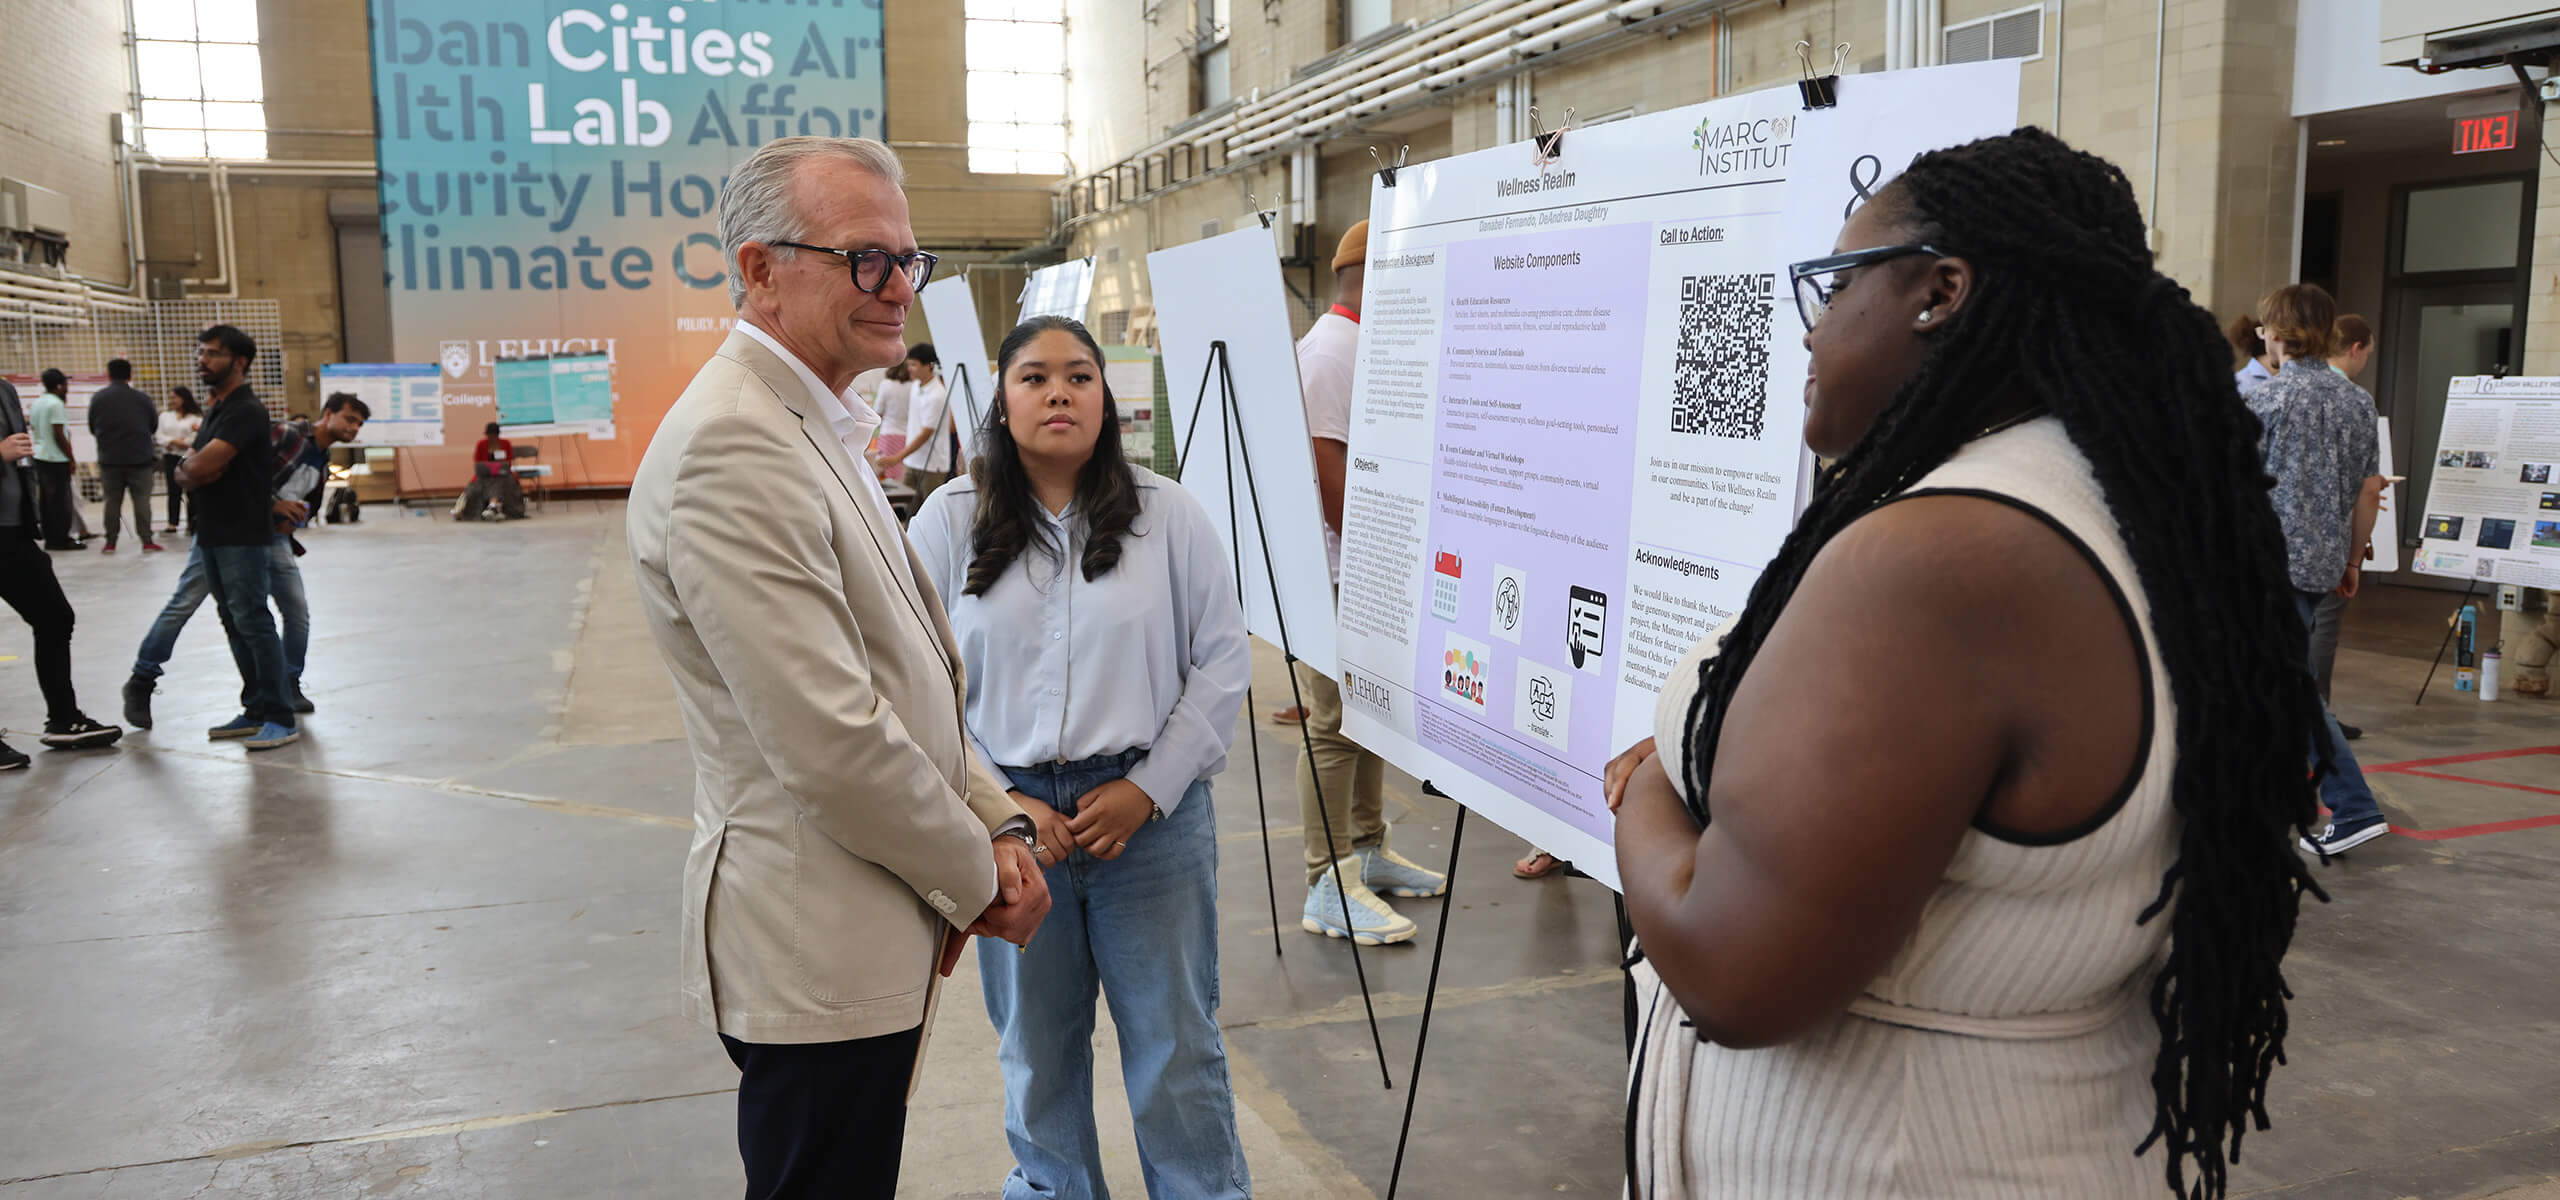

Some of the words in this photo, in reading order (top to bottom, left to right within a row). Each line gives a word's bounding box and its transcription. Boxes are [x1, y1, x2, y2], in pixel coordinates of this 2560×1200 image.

[372, 0, 529, 67] ban
[547, 3, 773, 78] Cities
[374, 72, 504, 142] lth
[528, 78, 671, 147] Lab
[688, 83, 885, 147] Affor
[611, 160, 738, 218] Ho
[1497, 177, 1541, 198] Wellness
[1542, 168, 1576, 191] Realm
[1505, 215, 1537, 230] Fernando,
[1538, 209, 1573, 225] DeAndrea
[1574, 205, 1608, 223] Daughtry
[1660, 228, 1677, 244] Call
[1679, 229, 1689, 242] to
[1690, 225, 1724, 242] Action:
[384, 223, 653, 291] limate
[1405, 251, 1434, 267] Background
[1494, 255, 1525, 272] Website
[1526, 250, 1581, 270] Components
[1593, 306, 1611, 317] disease
[2473, 376, 2493, 393] 16
[444, 393, 491, 407] College
[1587, 422, 1618, 437] personalized
[1649, 456, 1662, 468] Join
[1662, 460, 1670, 468] us
[1671, 459, 1678, 469] in
[1678, 462, 1690, 472] our
[1690, 461, 1715, 474] mission
[1715, 465, 1722, 475] to
[1723, 467, 1753, 481] empower
[1754, 467, 1781, 484] wellness
[1651, 472, 1657, 481] in
[1658, 475, 1669, 484] our
[1669, 476, 1710, 490] communities.
[1711, 480, 1727, 494] Visit
[1727, 483, 1756, 498] Wellness
[1756, 486, 1777, 501] Realm
[1670, 490, 1682, 501] and
[1682, 491, 1690, 503] be
[1695, 495, 1709, 508] part
[1709, 496, 1717, 508] of
[1717, 497, 1728, 509] the
[1728, 500, 1754, 516] change!
[1585, 537, 1608, 552] audience
[1635, 548, 1720, 581] Acknowledgments
[1633, 584, 1643, 596] We
[1644, 588, 1662, 601] would
[1662, 591, 1673, 604] like
[1674, 596, 1681, 605] to
[1681, 597, 1698, 611] thank
[1698, 599, 1709, 613] the
[1631, 599, 1645, 611] their
[1645, 604, 1671, 619] generous
[1671, 610, 1693, 625] support
[1693, 616, 1705, 629] and
[1630, 615, 1651, 628] project,
[1651, 619, 1661, 631] the
[1661, 622, 1687, 637] Marcon
[1629, 630, 1635, 640] of
[1636, 631, 1653, 645] Elders
[1654, 636, 1663, 647] for
[1663, 638, 1678, 651] their
[1625, 659, 1657, 678] mentorship,
[1648, 649, 1663, 663] Ochs
[1663, 655, 1673, 666] for
[1353, 674, 1391, 712] LEHIGH
[1624, 673, 1653, 690] dedication
